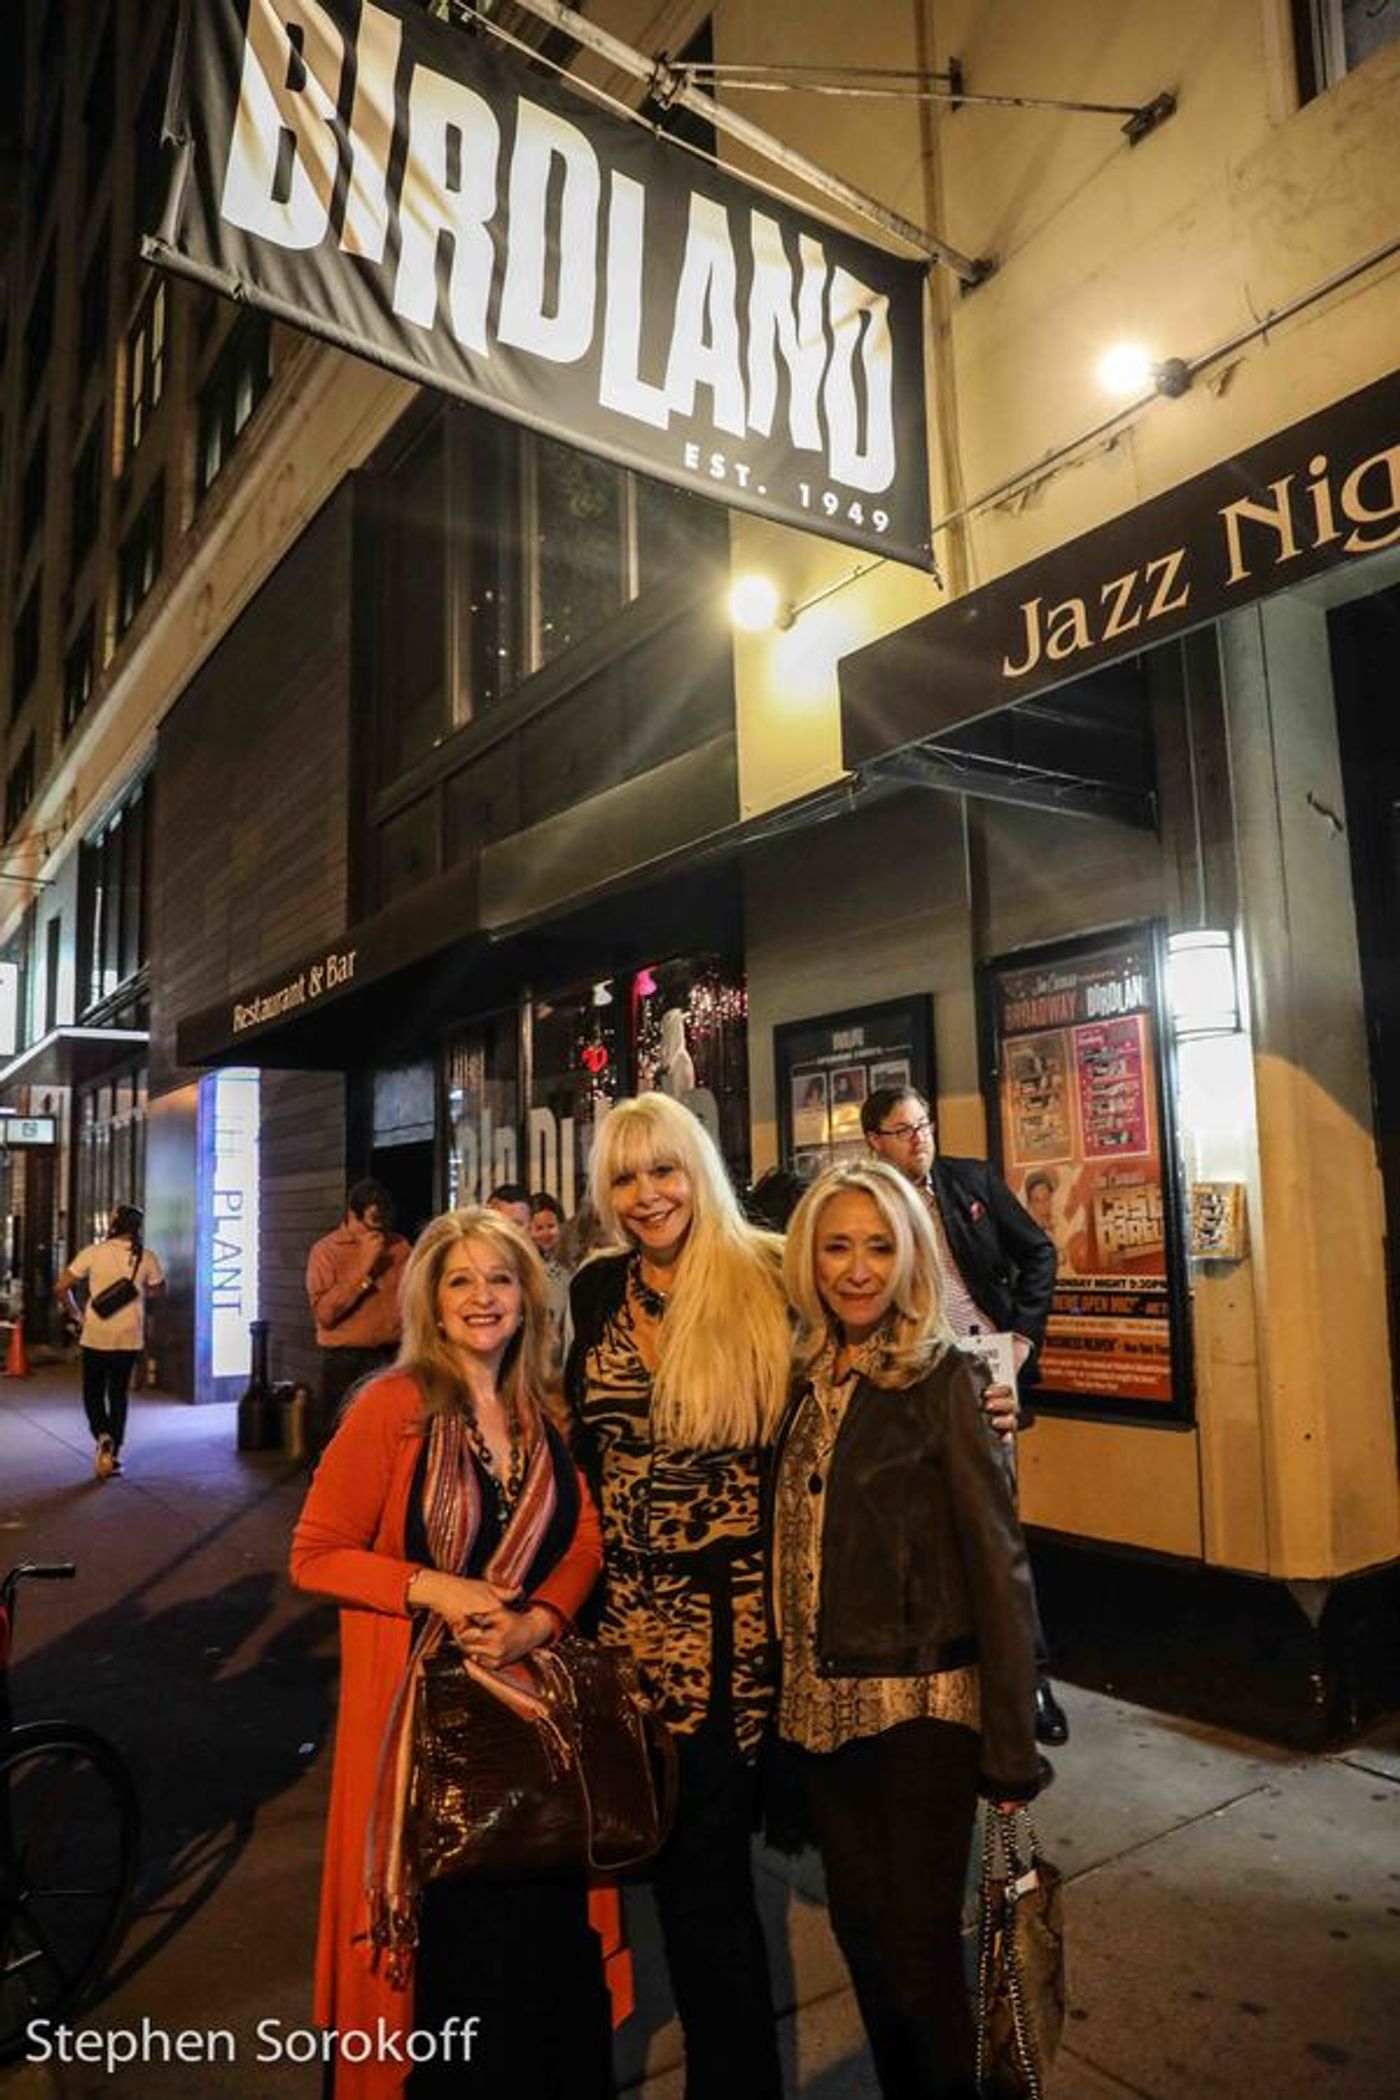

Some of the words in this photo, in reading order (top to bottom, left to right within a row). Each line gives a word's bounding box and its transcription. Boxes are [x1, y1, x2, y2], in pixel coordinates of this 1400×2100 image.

[221, 0, 897, 494] BIRDLAND
[684, 441, 767, 495] EST.
[799, 483, 889, 532] 1949
[1002, 548, 1191, 678] Jazz
[233, 973, 305, 1033] Restaurant
[308, 965, 324, 998] &
[326, 950, 356, 989] Bar
[213, 1189, 244, 1316] PLANT
